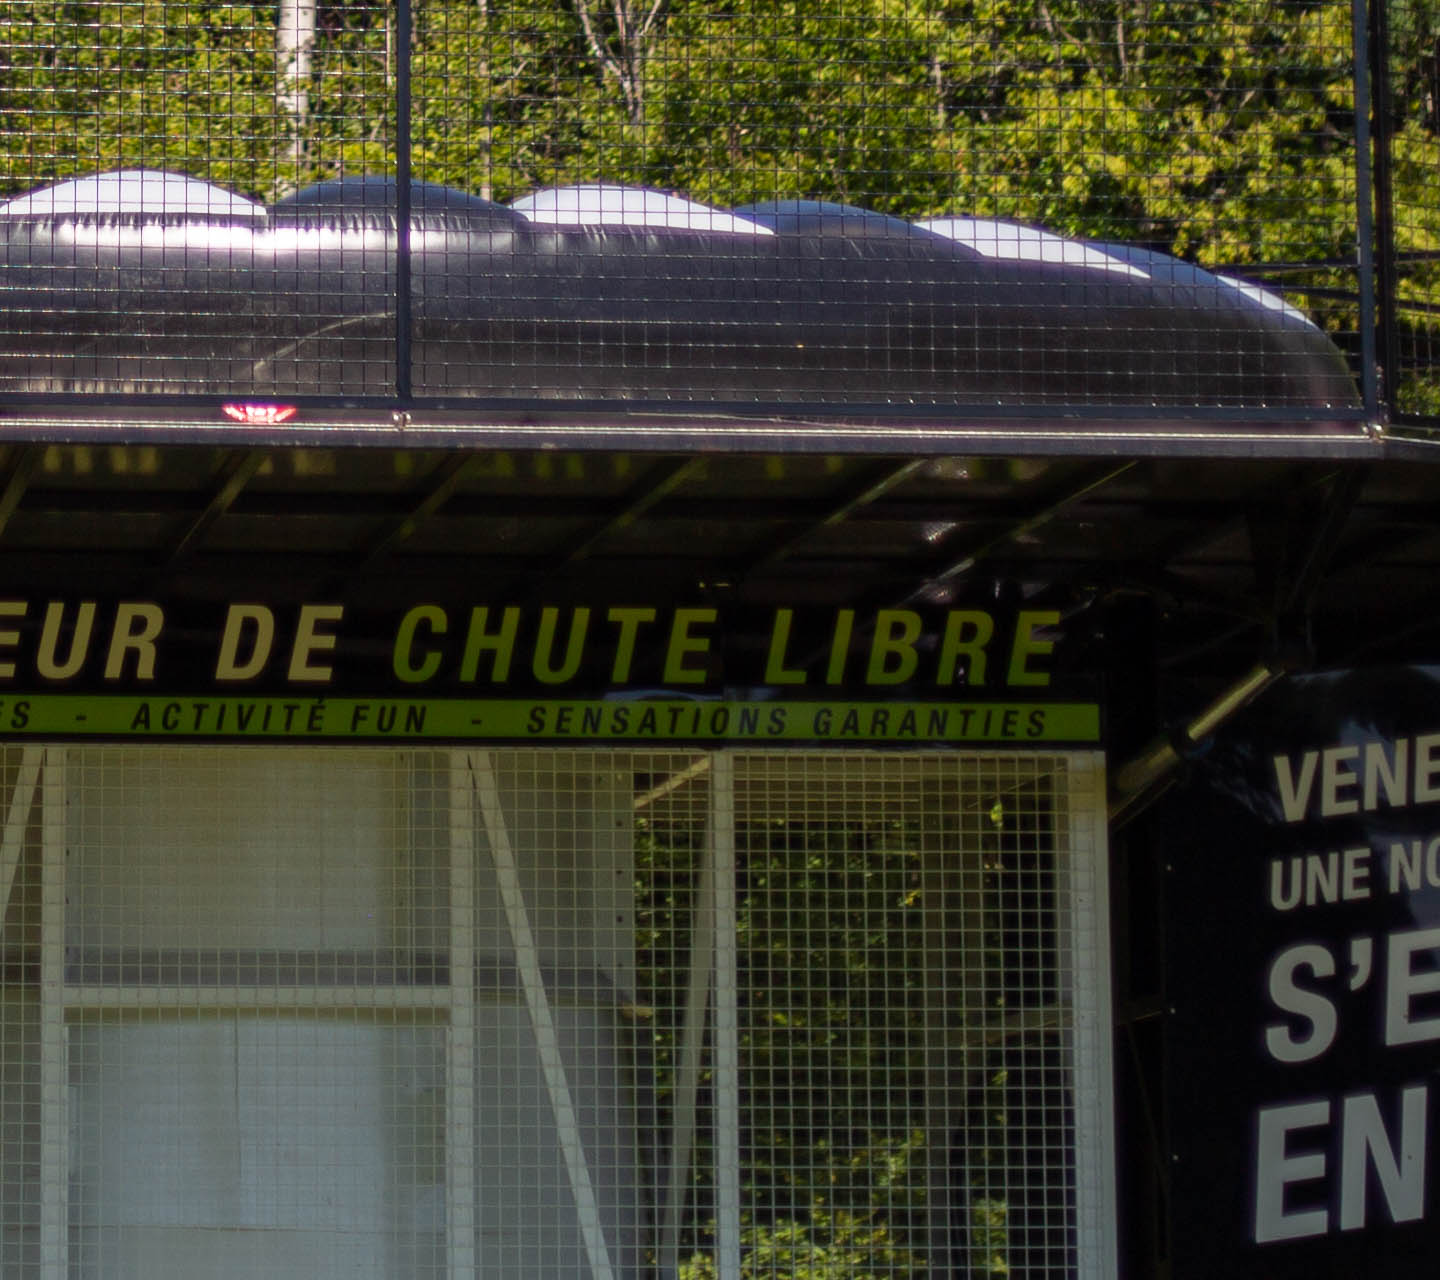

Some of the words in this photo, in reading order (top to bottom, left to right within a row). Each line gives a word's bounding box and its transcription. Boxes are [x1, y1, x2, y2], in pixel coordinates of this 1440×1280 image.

[214, 603, 345, 681] DE
[392, 604, 720, 684] CHUTE
[763, 608, 1063, 686] LIBRE
[130, 696, 328, 734] ACTIVITÉ
[350, 703, 427, 734] FUN
[526, 705, 788, 738] SENSATIONS
[812, 707, 1046, 738] GARANTIES
[1269, 847, 1371, 911] UNE
[1254, 1085, 1428, 1244] EN
